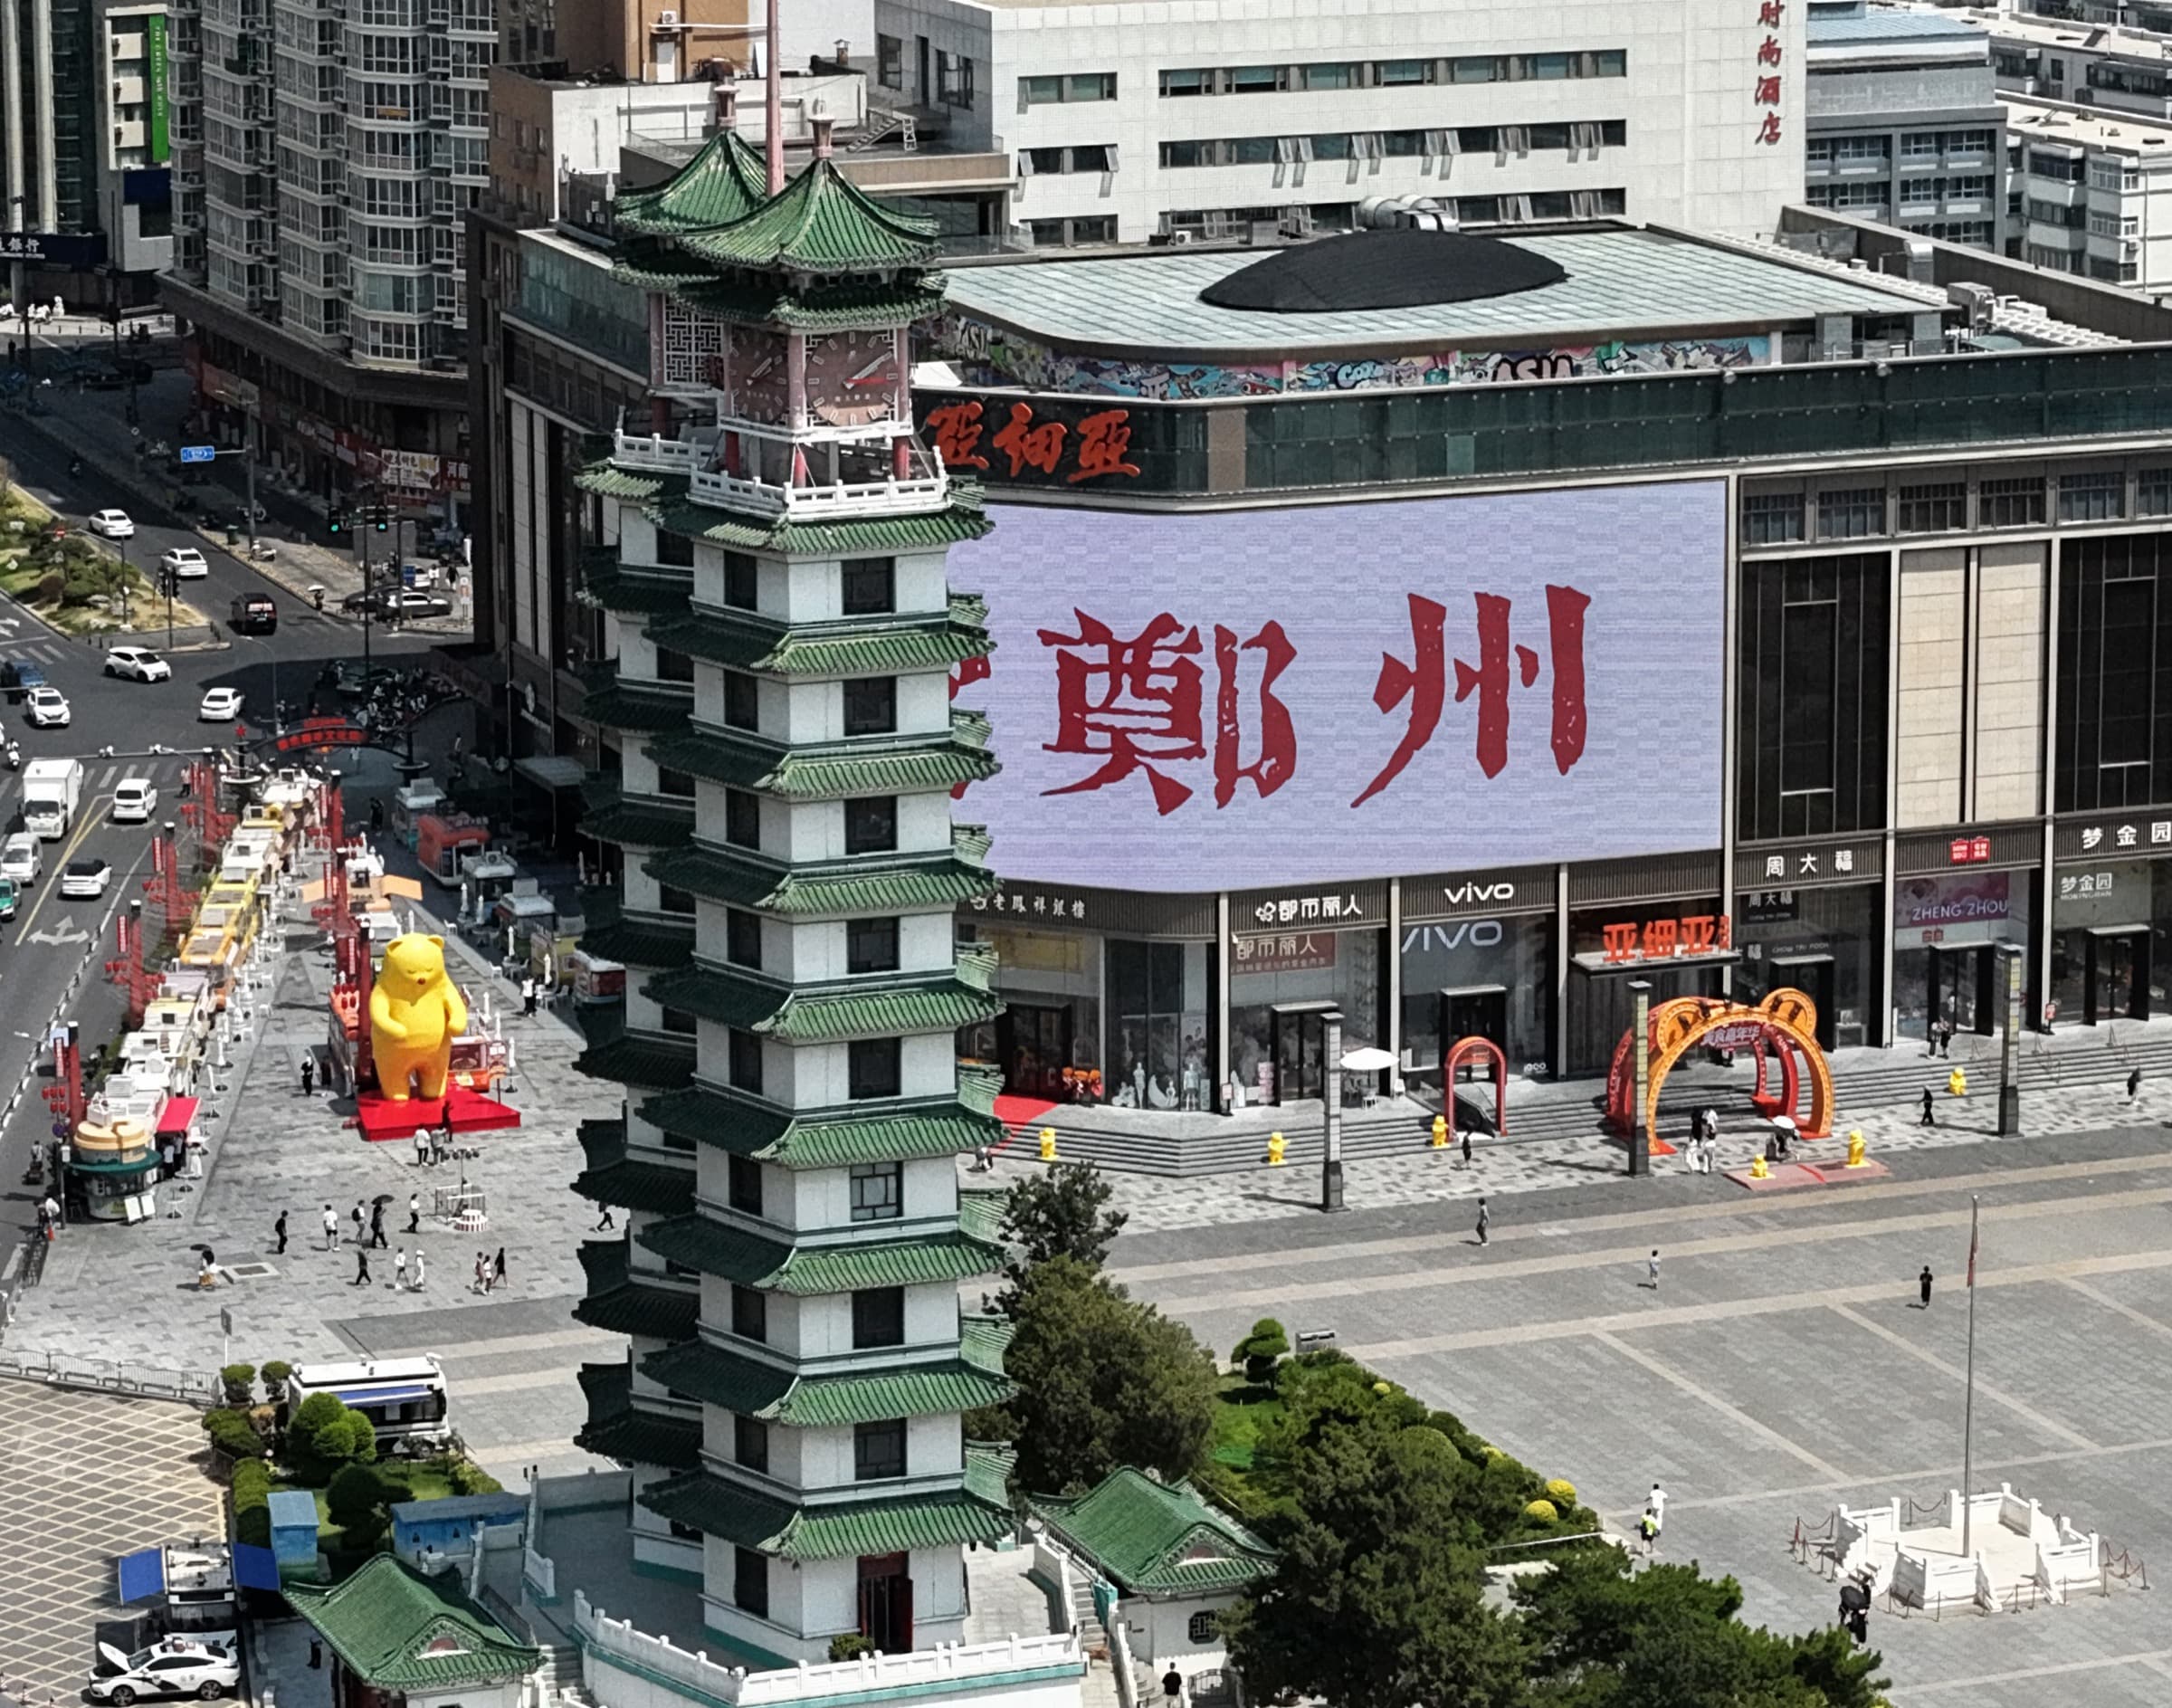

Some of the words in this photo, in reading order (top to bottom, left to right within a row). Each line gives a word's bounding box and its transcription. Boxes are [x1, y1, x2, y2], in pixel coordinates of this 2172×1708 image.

[948, 585, 1592, 816] 鄭州
[2082, 821, 2171, 849] 梦金园
[1766, 850, 1853, 877] 周大福
[1444, 881, 1514, 904] vivo
[2061, 873, 2112, 893] 梦金园
[1279, 894, 1362, 921] 都市丽人
[1912, 905, 1962, 921] ZHENG
[1967, 900, 2008, 916] ZHOU
[1236, 935, 1318, 960] 都市丽人
[1603, 915, 1715, 962] 亚细亚
